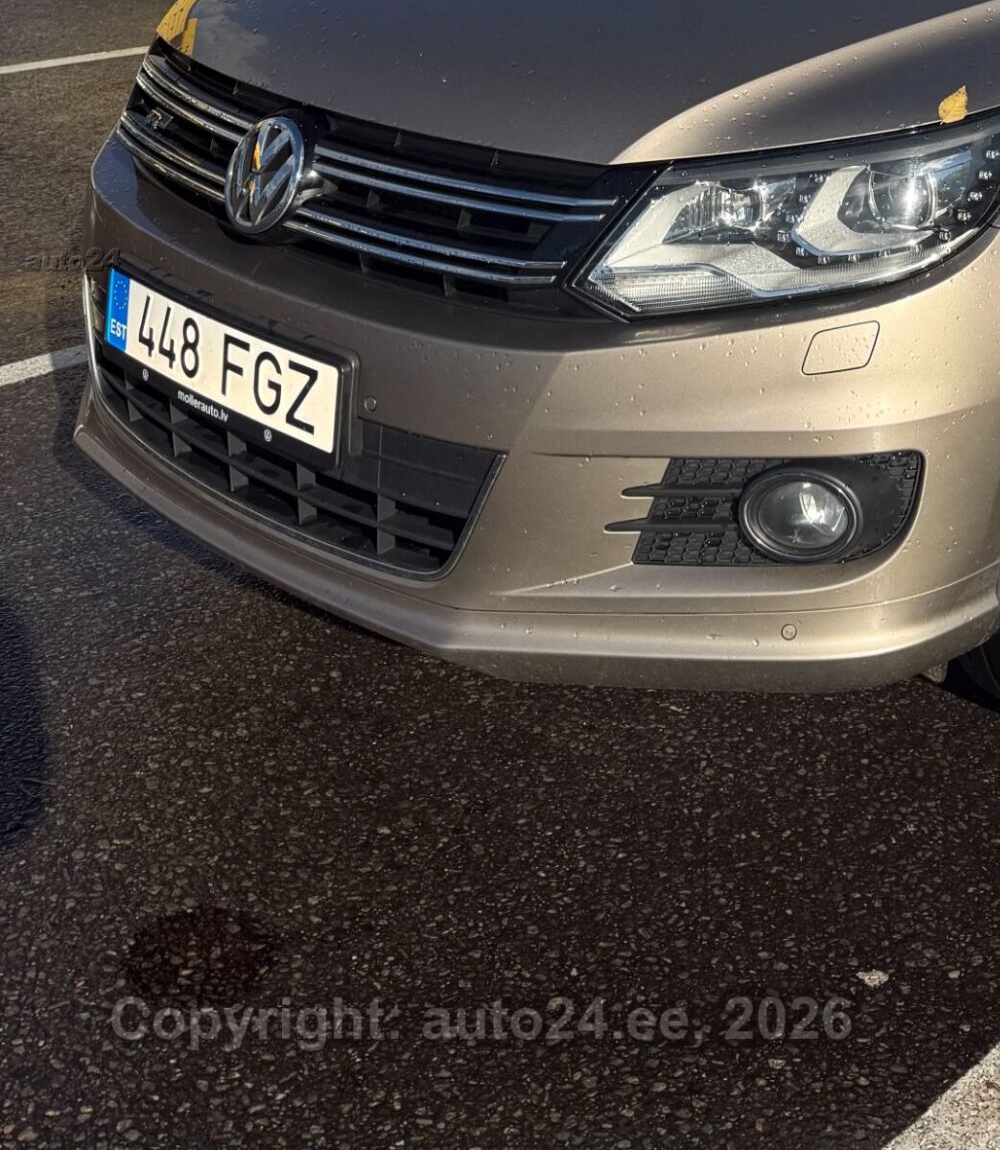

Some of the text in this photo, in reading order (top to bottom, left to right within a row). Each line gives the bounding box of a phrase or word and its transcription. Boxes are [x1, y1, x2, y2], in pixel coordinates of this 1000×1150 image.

[110, 318, 127, 340] EST
[138, 295, 319, 435] 448 FGZ
[177, 389, 229, 423] mollerauto.lv
